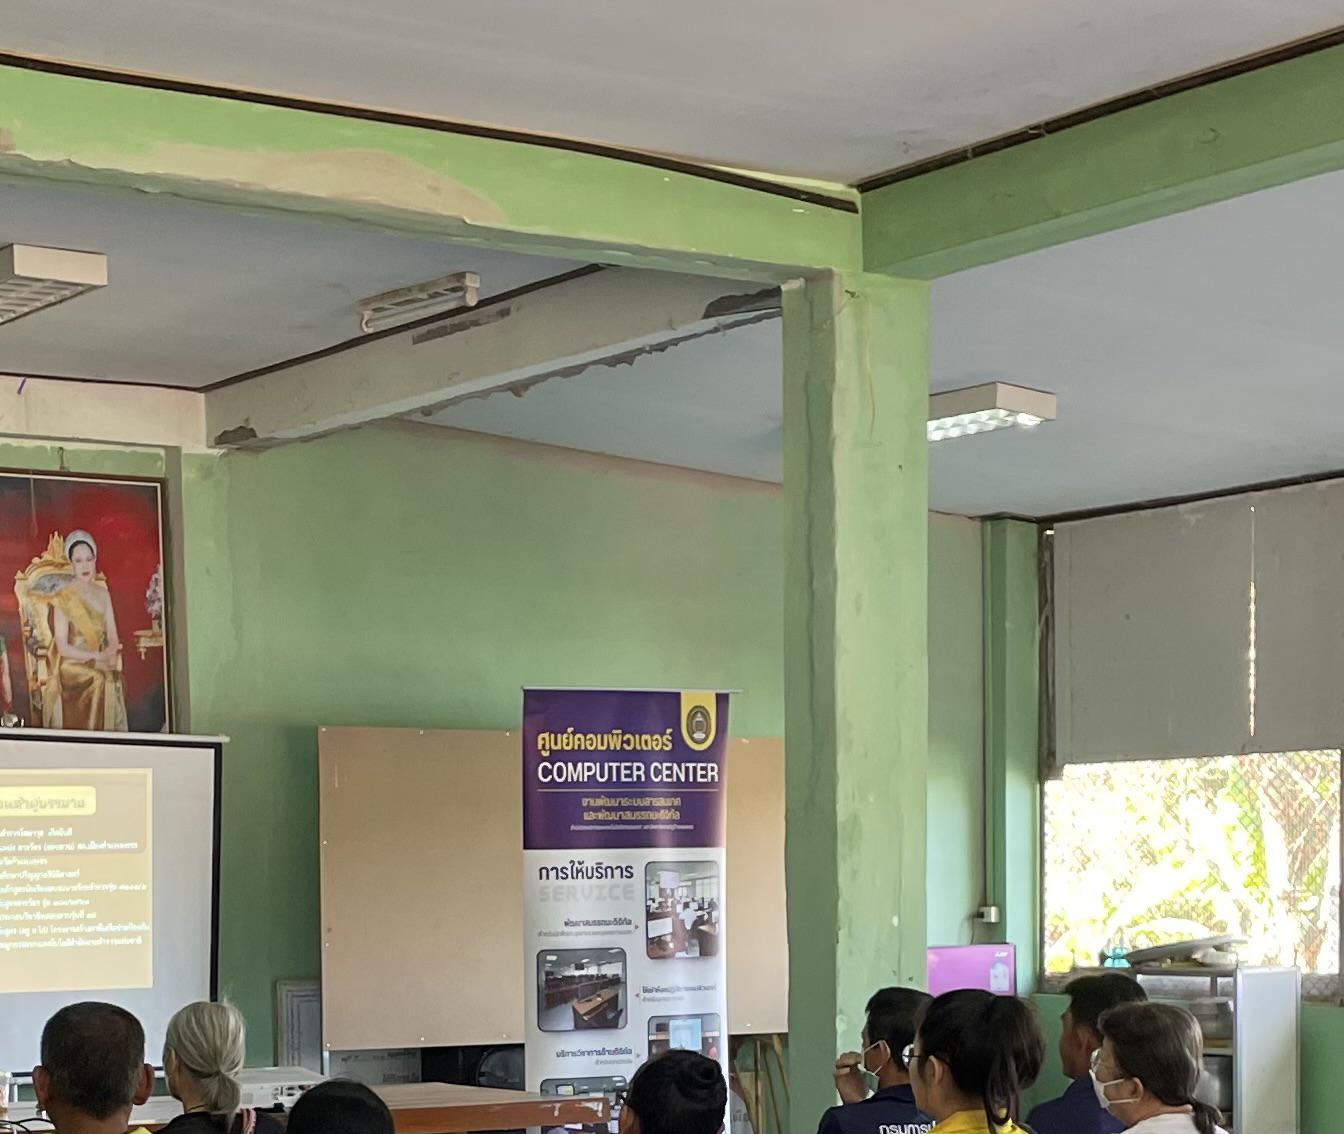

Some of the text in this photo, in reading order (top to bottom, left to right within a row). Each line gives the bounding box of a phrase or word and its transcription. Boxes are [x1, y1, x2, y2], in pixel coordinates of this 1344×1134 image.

[538, 728, 673, 754] ศูนย์คอมพิวเตอร์
[538, 761, 719, 783] COMPUTER CENTER
[539, 860, 634, 880] การให้บริการ
[539, 883, 635, 901] SERVICE
